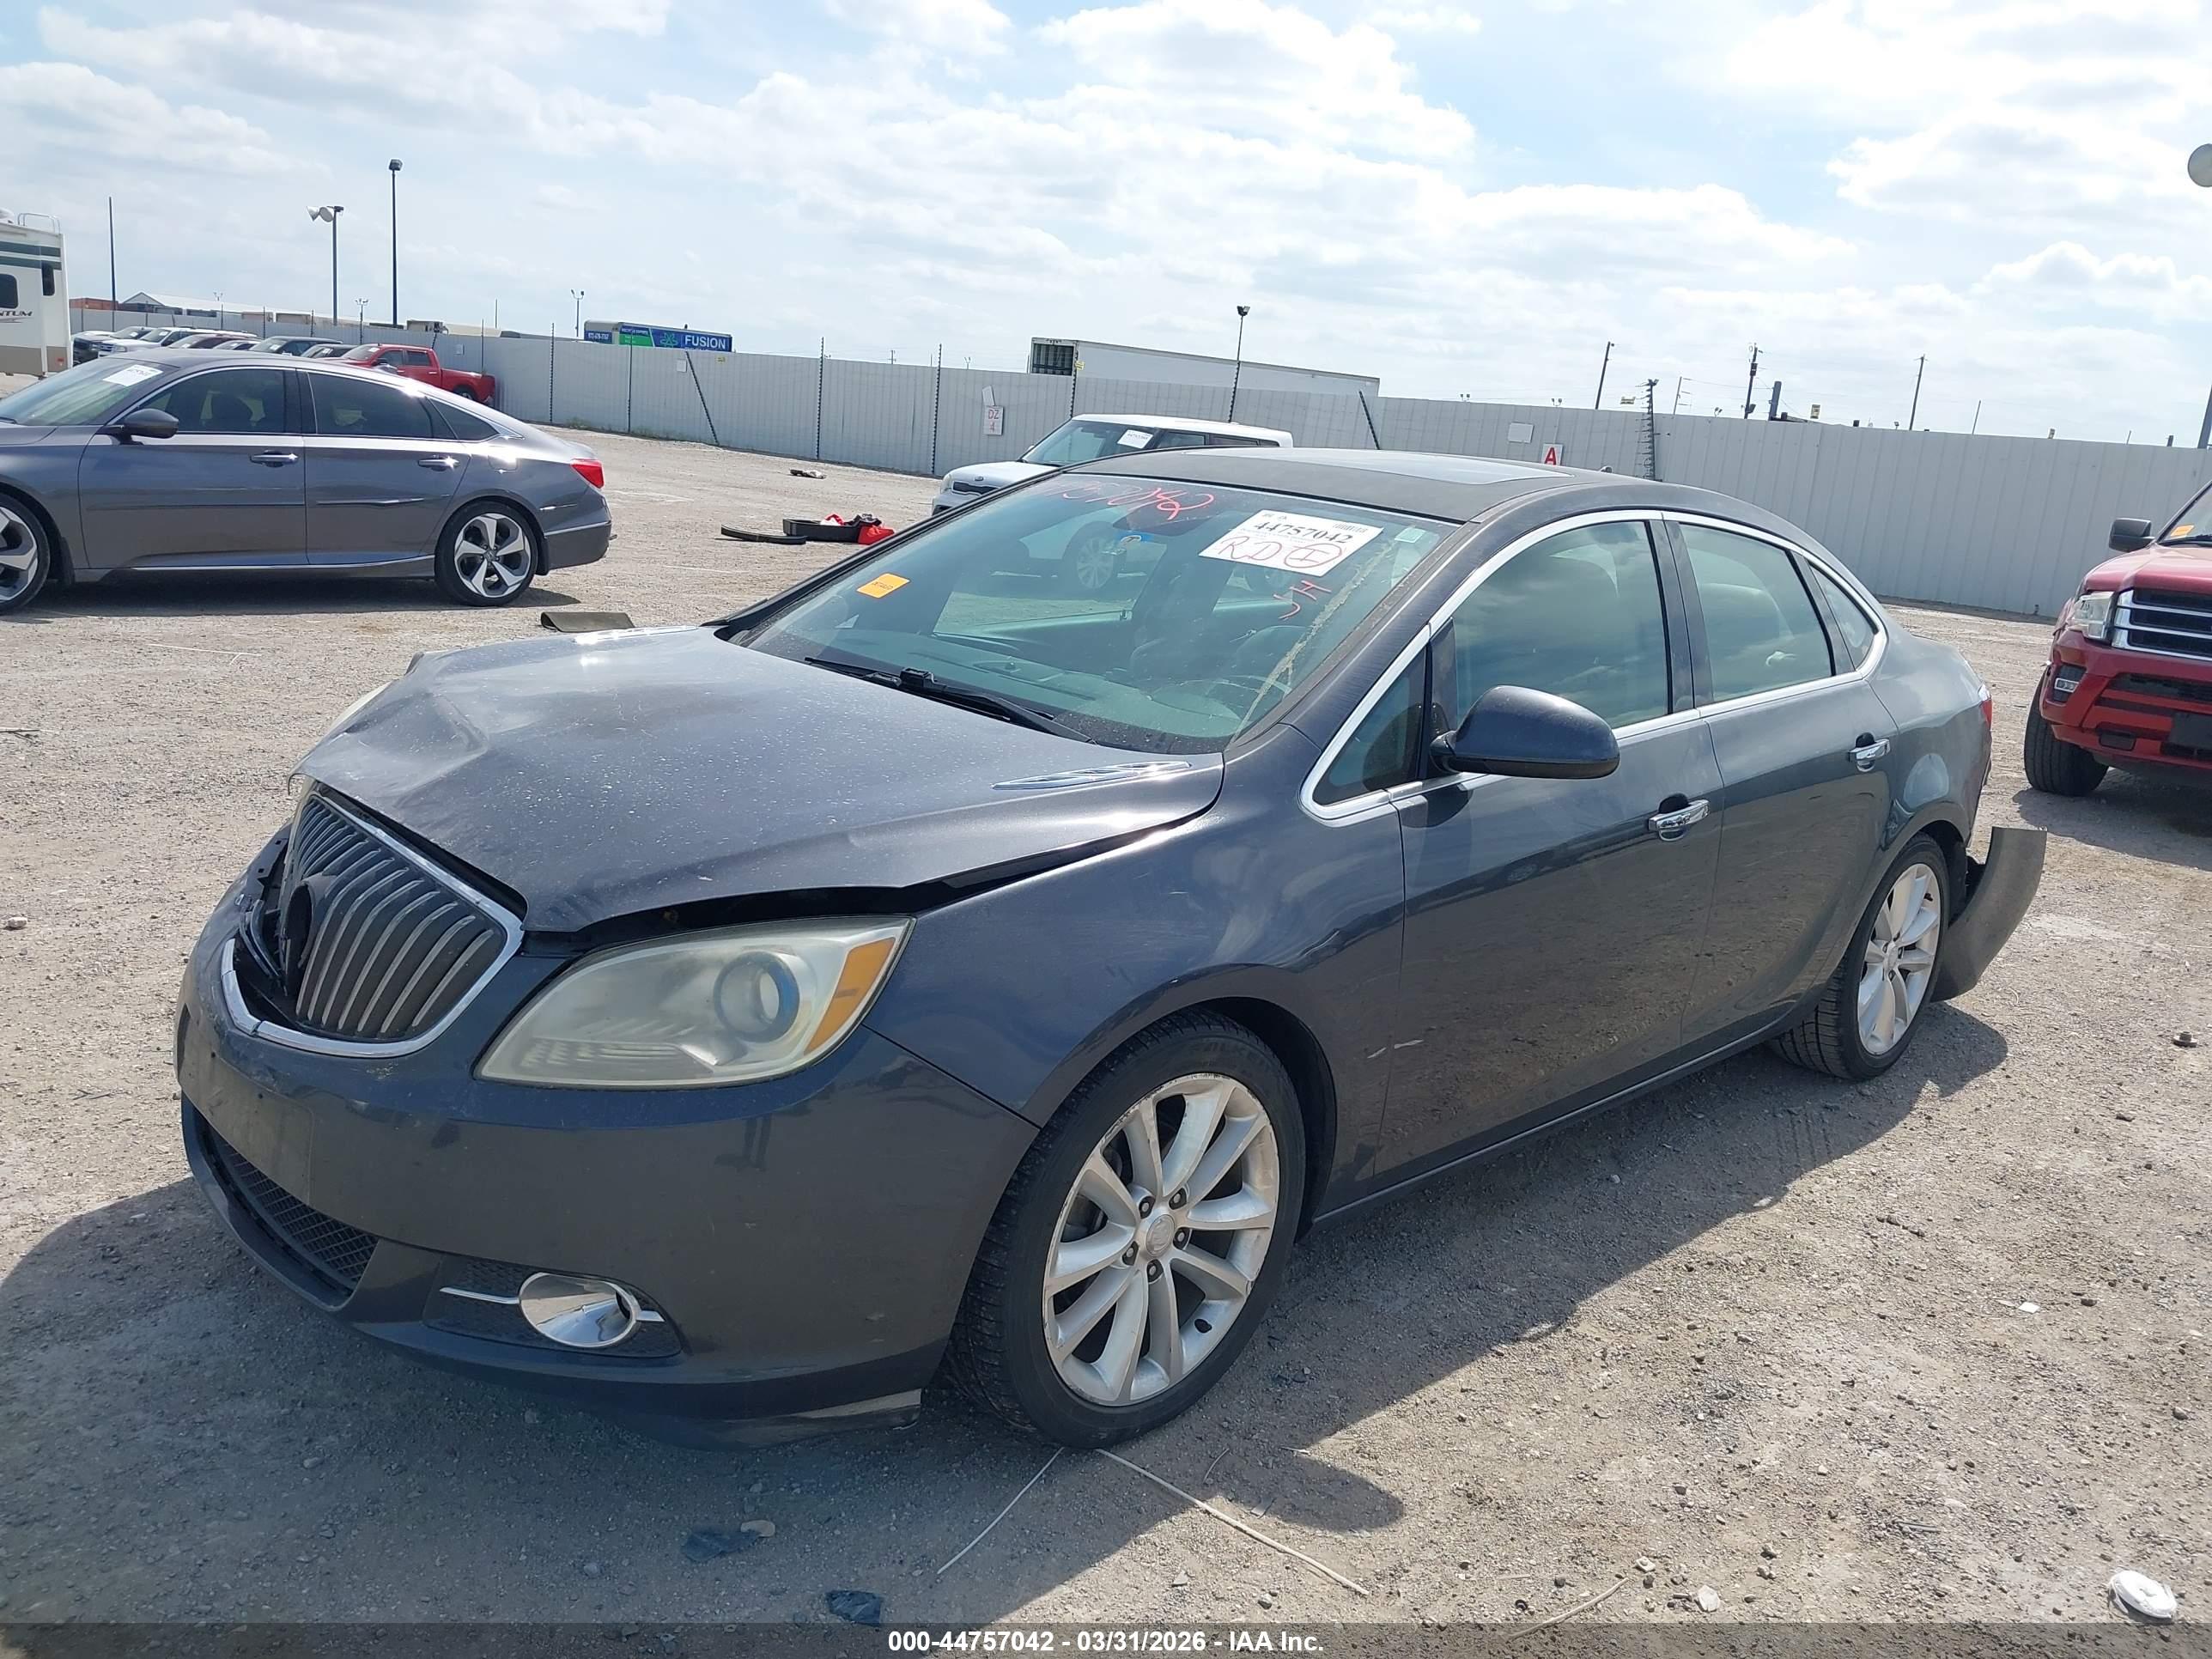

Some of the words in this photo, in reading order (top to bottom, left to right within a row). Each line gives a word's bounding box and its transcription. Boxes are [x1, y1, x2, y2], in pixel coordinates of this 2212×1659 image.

[685, 334, 726, 349] FUSION
[1544, 447, 1557, 465] A
[1254, 521, 1354, 544] 44757042
